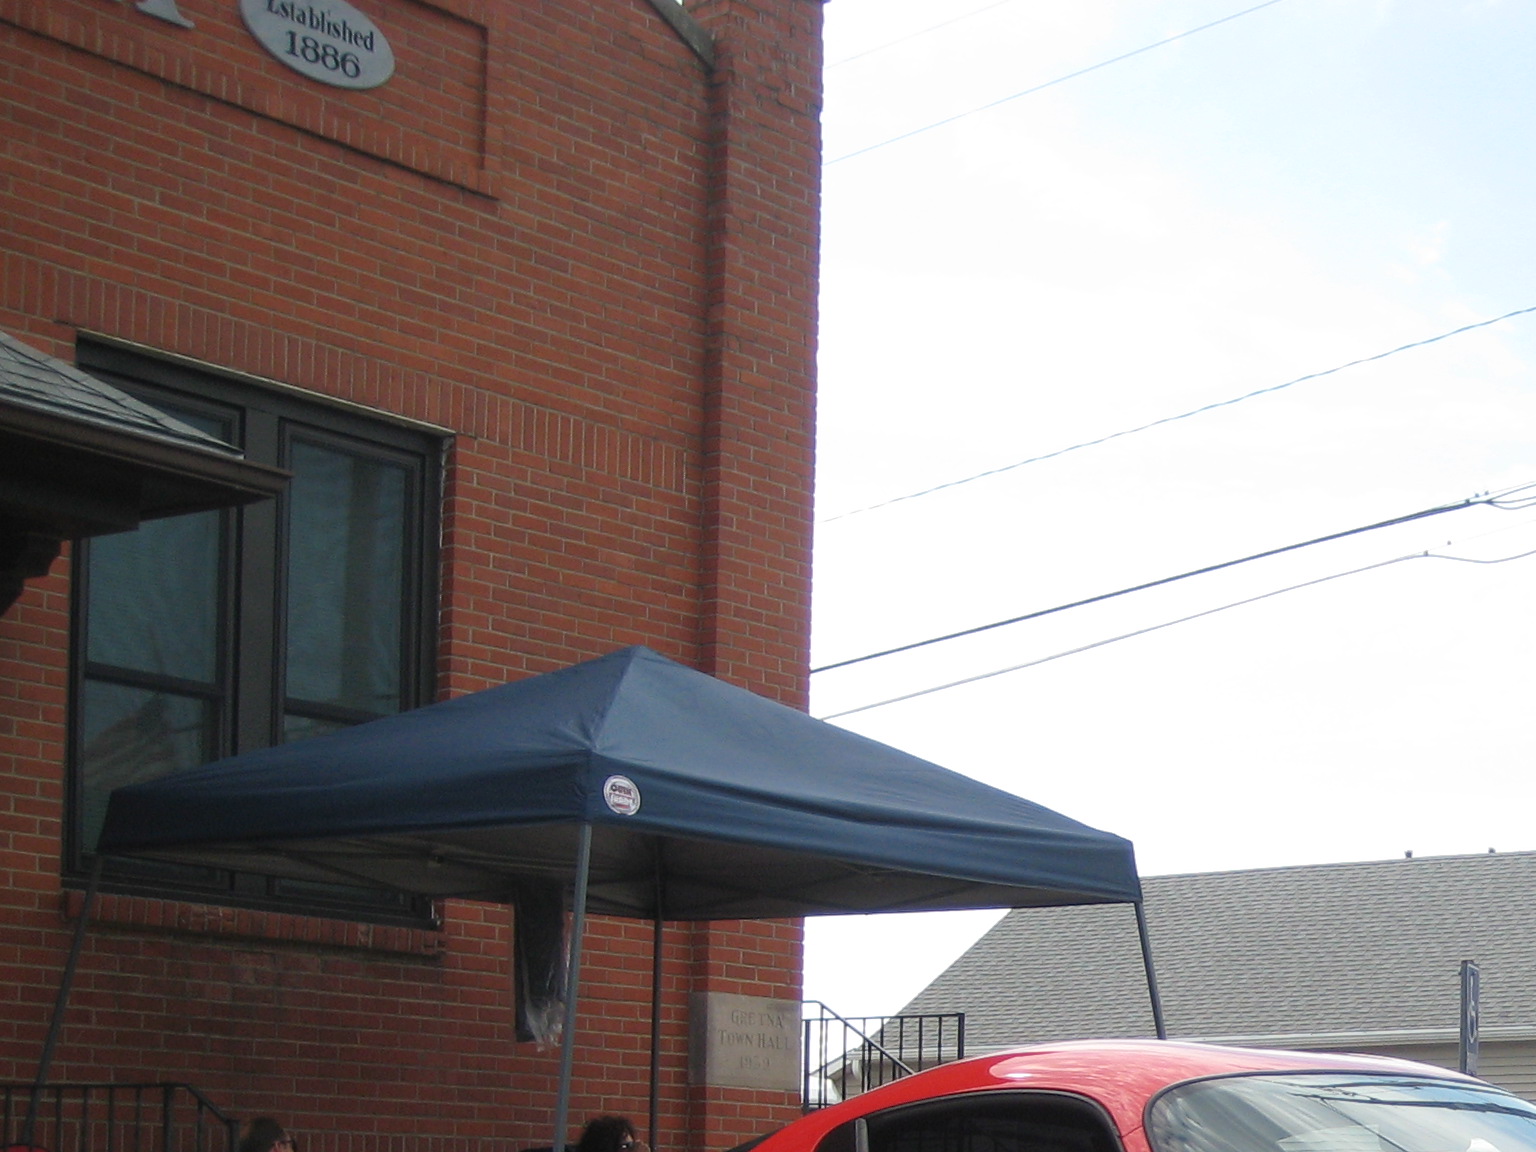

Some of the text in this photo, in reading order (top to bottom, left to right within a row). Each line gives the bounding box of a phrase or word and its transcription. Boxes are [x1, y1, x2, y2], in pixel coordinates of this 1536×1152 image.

[267, 0, 375, 52] Established
[285, 30, 361, 78] 1886
[731, 1009, 784, 1029] GRETNA
[718, 1029, 791, 1051] TOWN HALL
